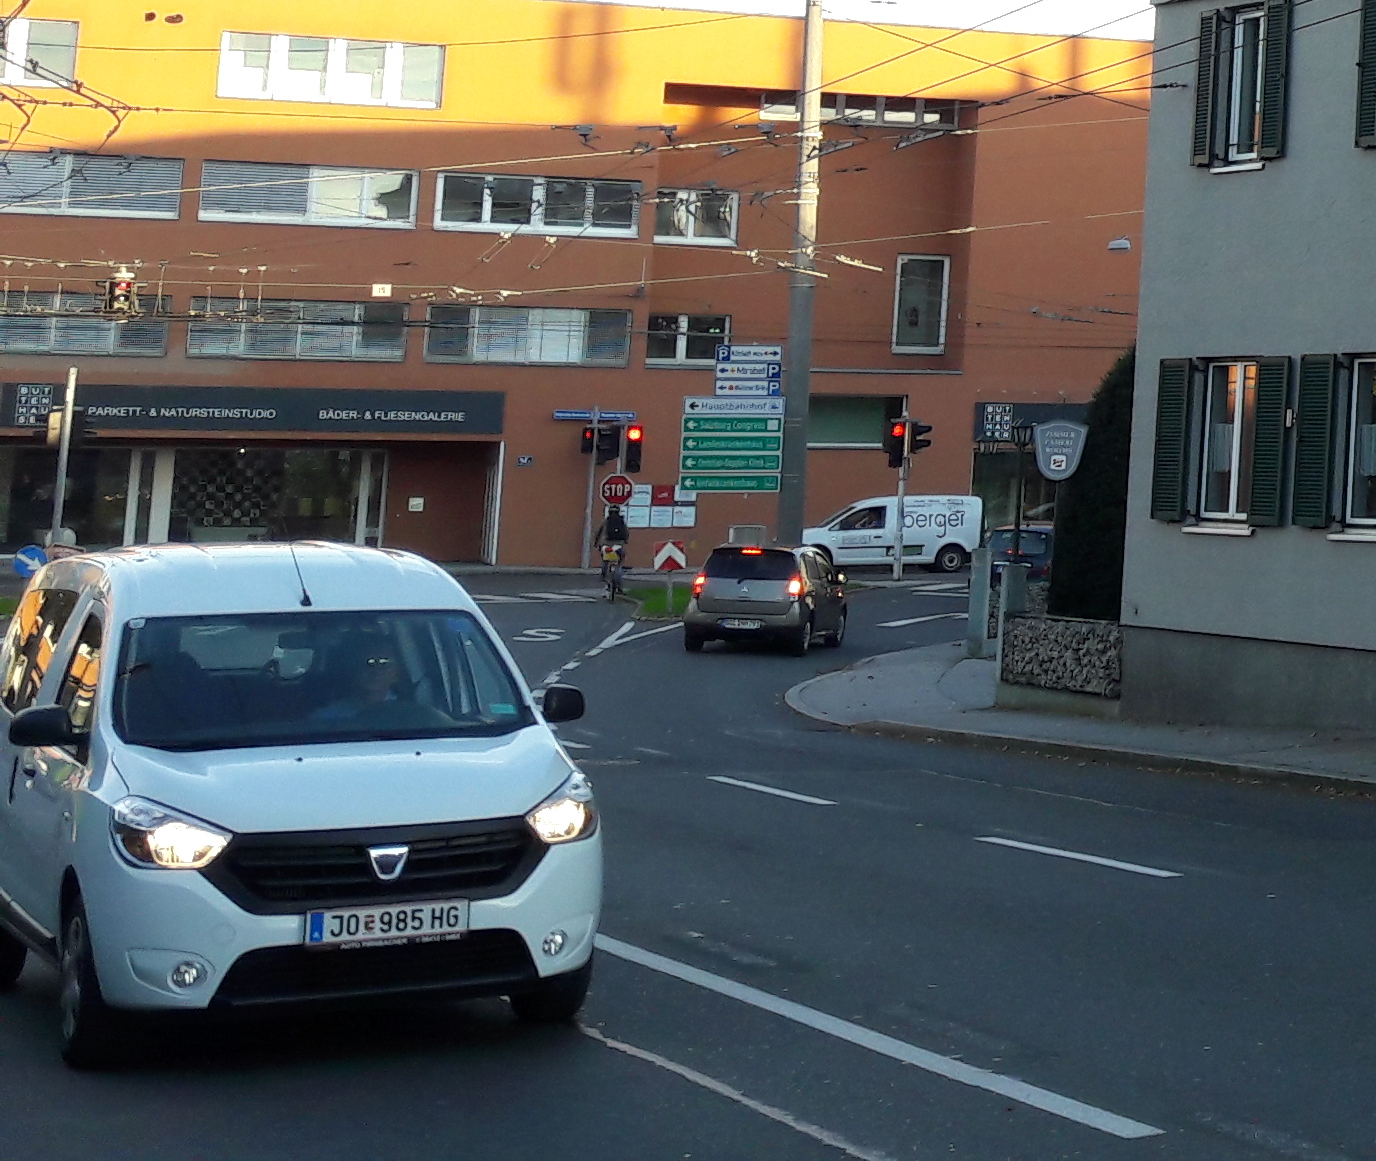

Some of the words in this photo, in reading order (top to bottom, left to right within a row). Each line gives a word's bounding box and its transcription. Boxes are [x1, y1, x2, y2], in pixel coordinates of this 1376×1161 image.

[87, 406, 147, 417] PARKETT-
[149, 407, 158, 418] &
[159, 407, 277, 419] NATURSTEINSTUDIO
[701, 401, 768, 412] Hauptbahnhof
[318, 407, 362, 421] BÄDER-
[364, 410, 373, 420] &
[374, 410, 466, 422] FLIESENGALERIE
[603, 483, 631, 497] STOP
[329, 913, 360, 938] JO
[379, 909, 425, 934] 985
[430, 905, 460, 929] HG
